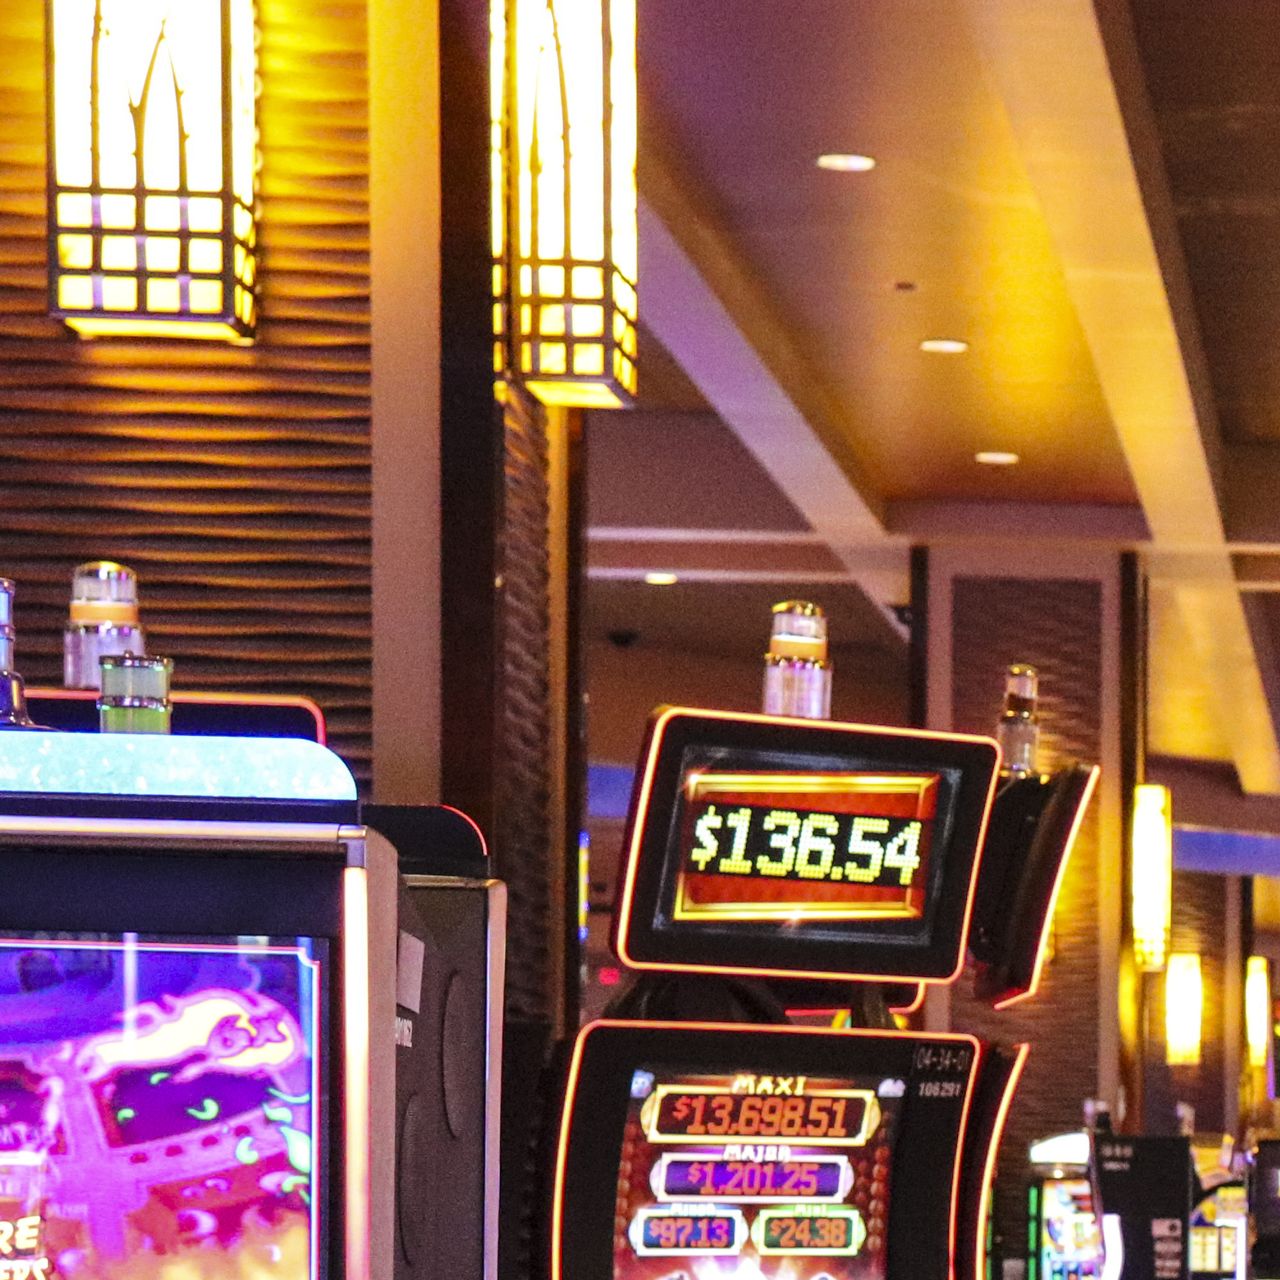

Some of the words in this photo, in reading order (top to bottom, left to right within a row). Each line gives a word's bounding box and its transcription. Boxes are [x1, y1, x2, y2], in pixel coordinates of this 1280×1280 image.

[692, 804, 922, 886] $136.54
[731, 1074, 807, 1095] MAXI
[673, 1095, 847, 1137] $13,698.51
[723, 1145, 791, 1163] MAJOR
[688, 1162, 819, 1195] $1,201.25
[649, 1217, 729, 1248] $97.13
[770, 1217, 847, 1248] $24.38
